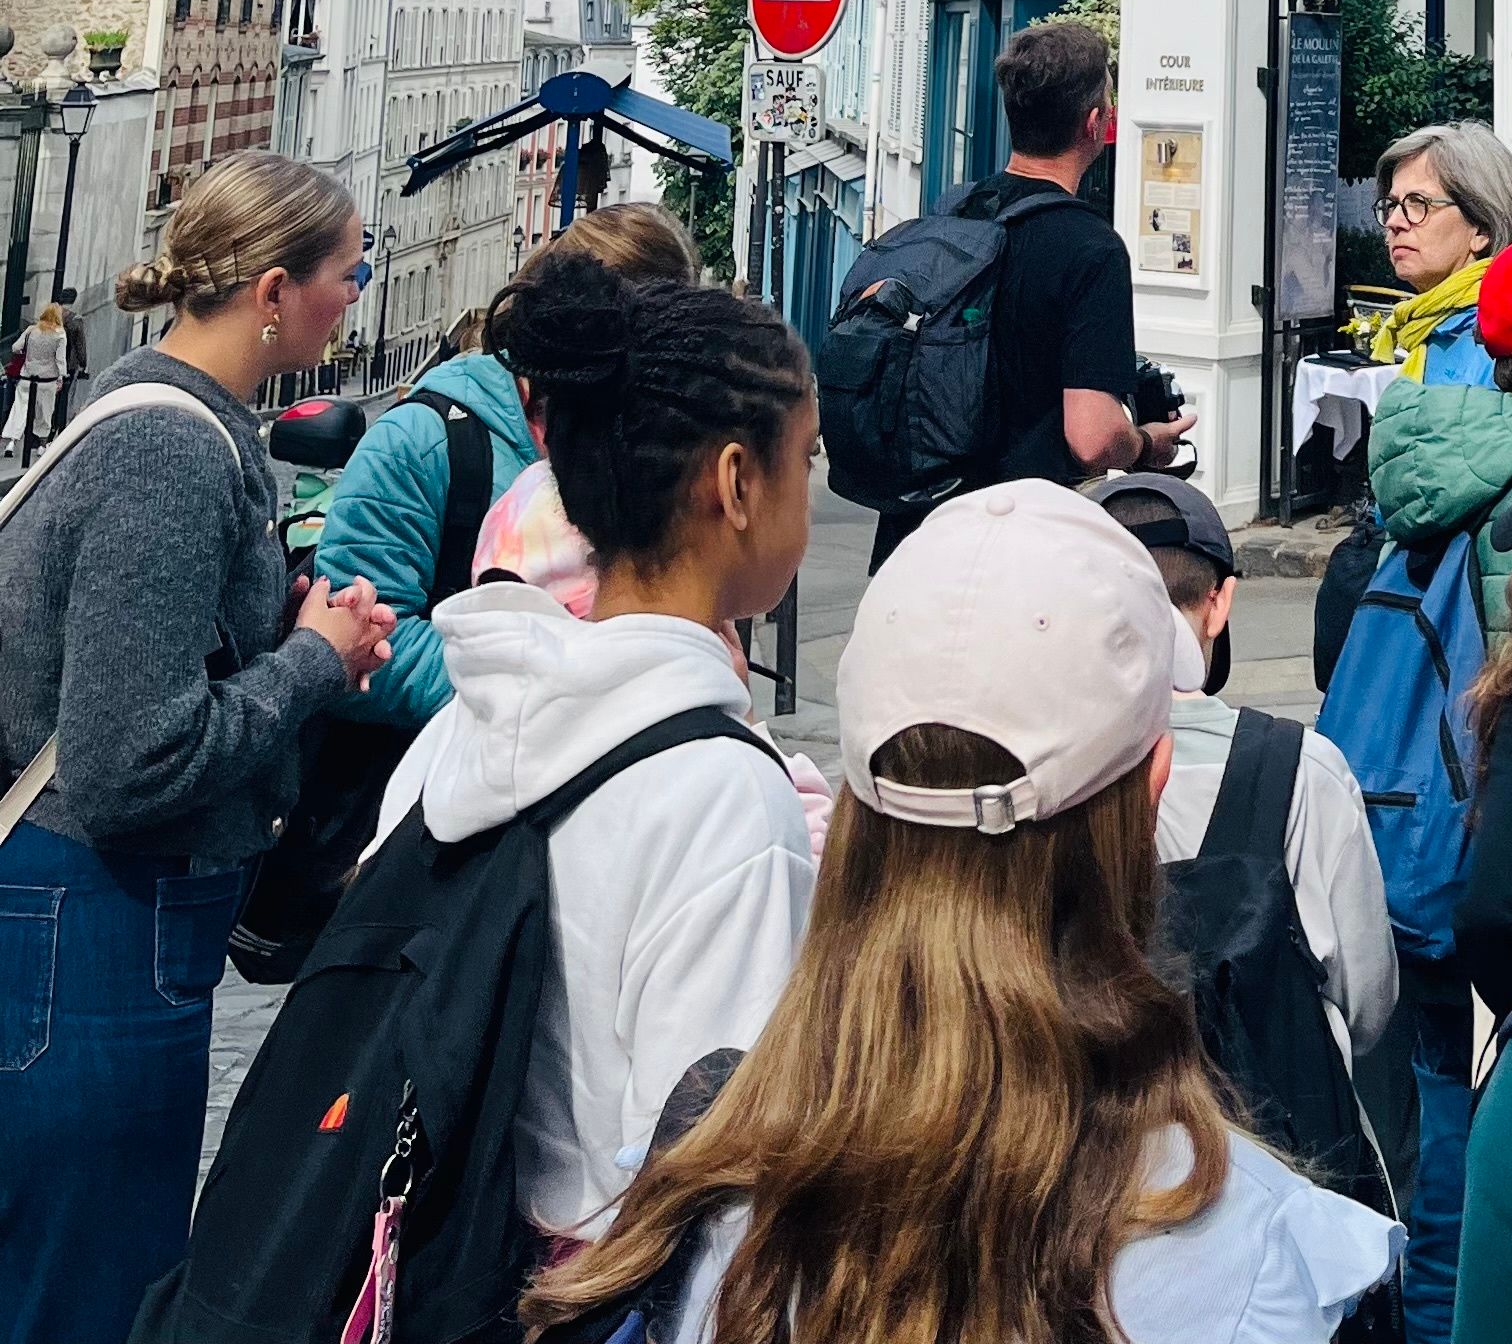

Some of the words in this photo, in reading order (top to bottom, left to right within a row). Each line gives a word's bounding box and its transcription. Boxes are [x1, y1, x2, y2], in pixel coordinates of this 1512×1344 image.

[1291, 37, 1302, 50] LE
[1303, 37, 1340, 51] MOULIN
[1160, 55, 1191, 68] COUR
[766, 69, 804, 88] SAUF
